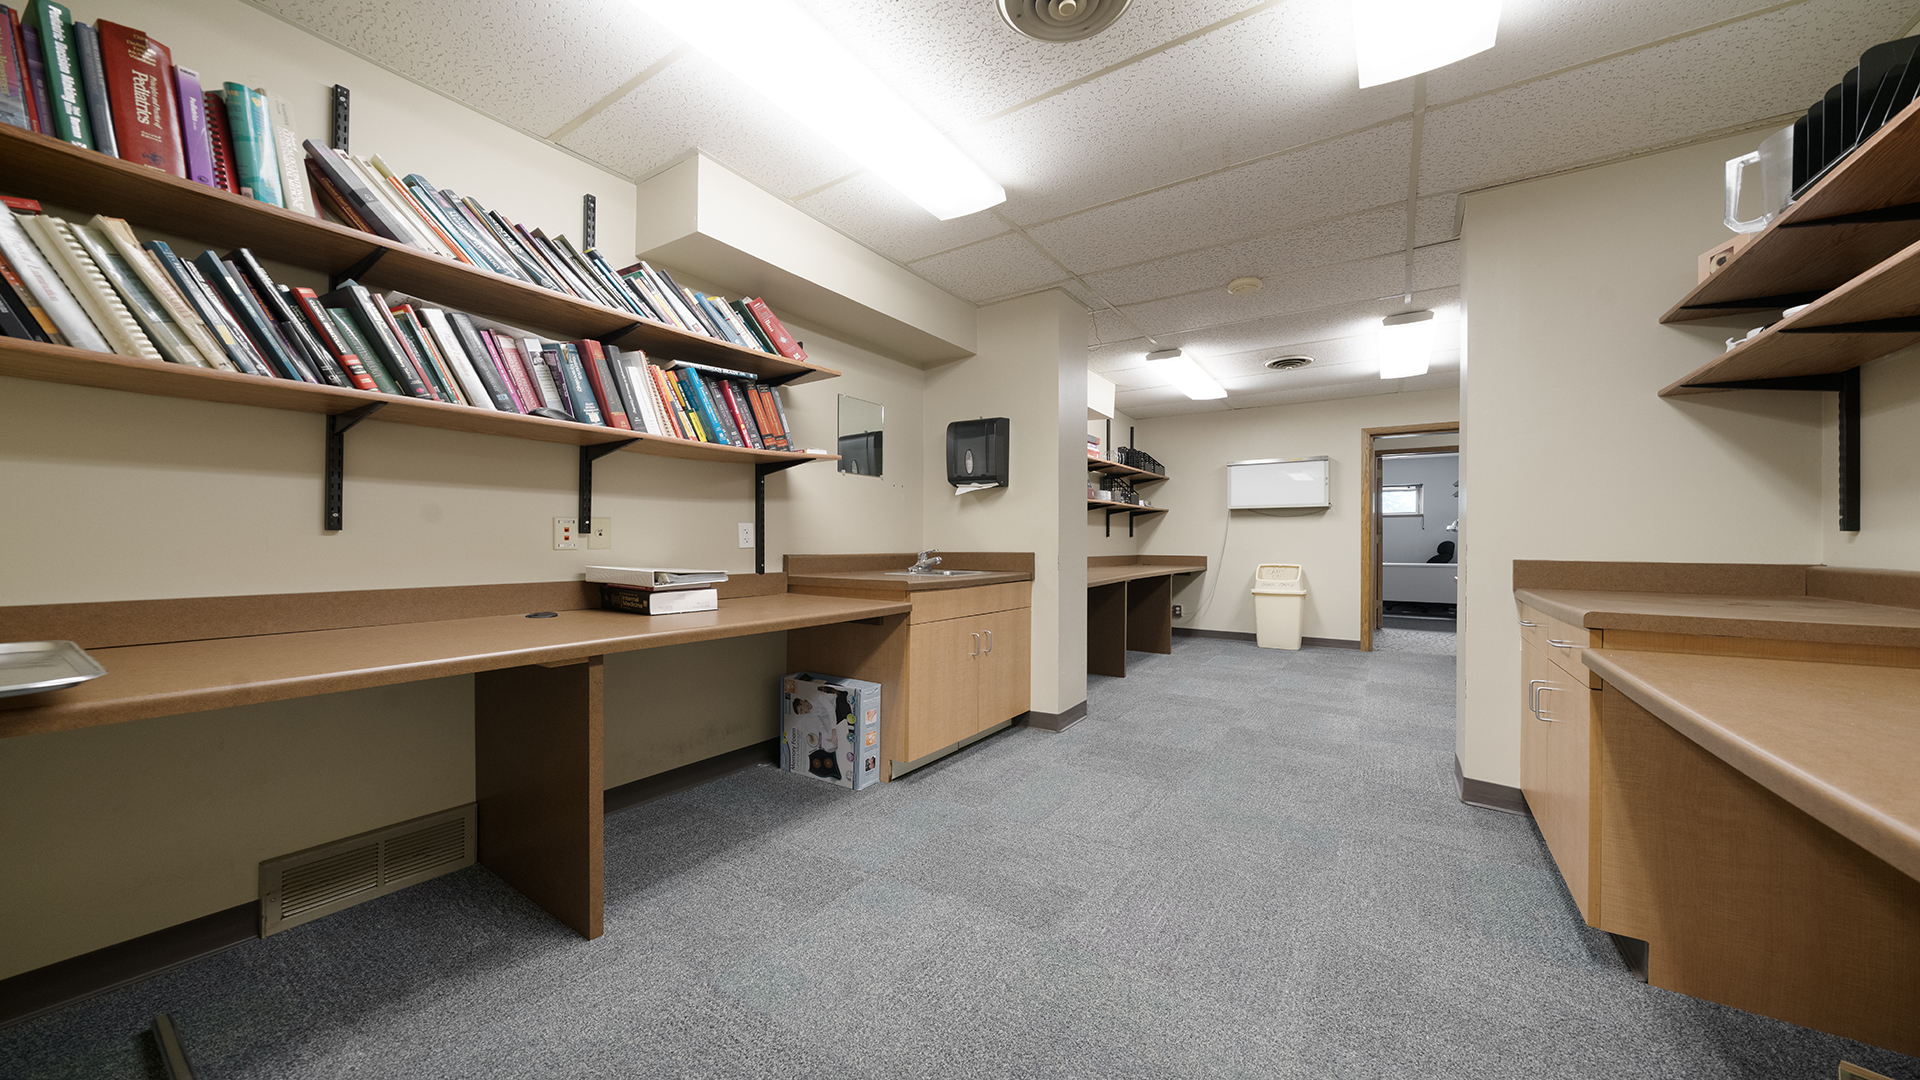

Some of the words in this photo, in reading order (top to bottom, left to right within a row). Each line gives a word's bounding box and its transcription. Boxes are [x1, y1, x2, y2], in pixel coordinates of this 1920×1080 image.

[48, 4, 66, 41] Pediatric
[54, 40, 71, 74] Decision
[60, 73, 77, 104] Making
[131, 69, 150, 125] Pediatrics
[189, 96, 198, 122] Pediatrics
[320, 177, 338, 197] Effective
[336, 195, 349, 208] Staff
[346, 205, 371, 233] Development
[309, 299, 325, 323] CLINICAL
